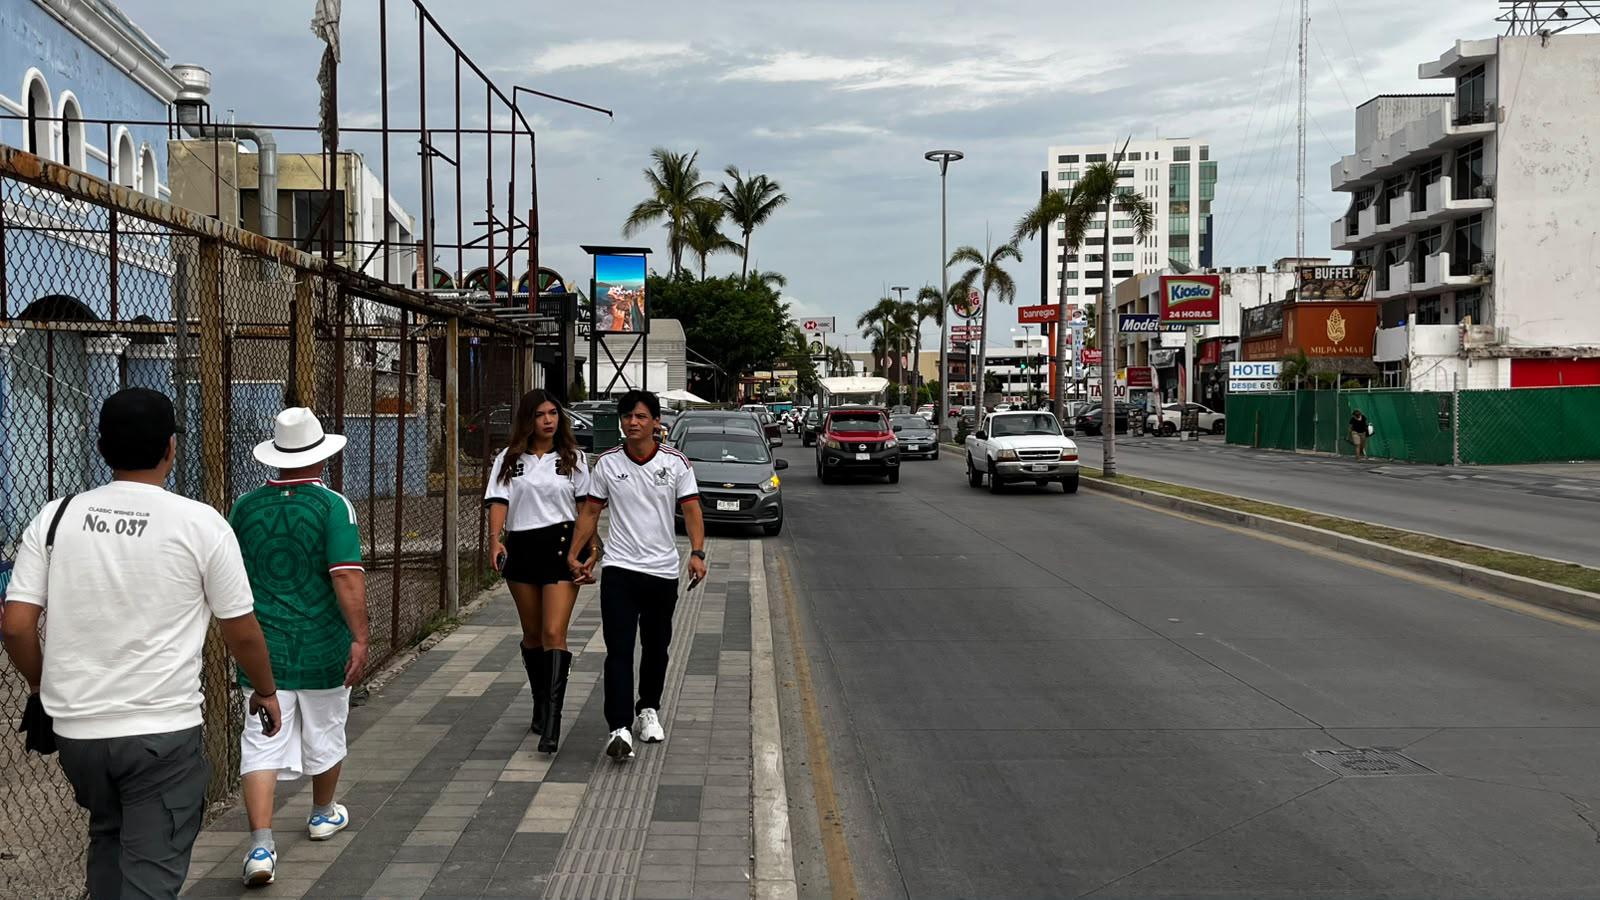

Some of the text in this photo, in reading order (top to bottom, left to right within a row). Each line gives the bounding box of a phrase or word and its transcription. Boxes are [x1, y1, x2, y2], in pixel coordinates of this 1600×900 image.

[1315, 267, 1355, 279] BUFFET
[1171, 285, 1210, 300] Kiosko
[1310, 346, 1337, 354] MILPA
[1232, 364, 1279, 376] HOTEL
[1089, 385, 1125, 397] TAOO
[88, 506, 112, 514] CLASSIC
[83, 513, 148, 538] No. 037
